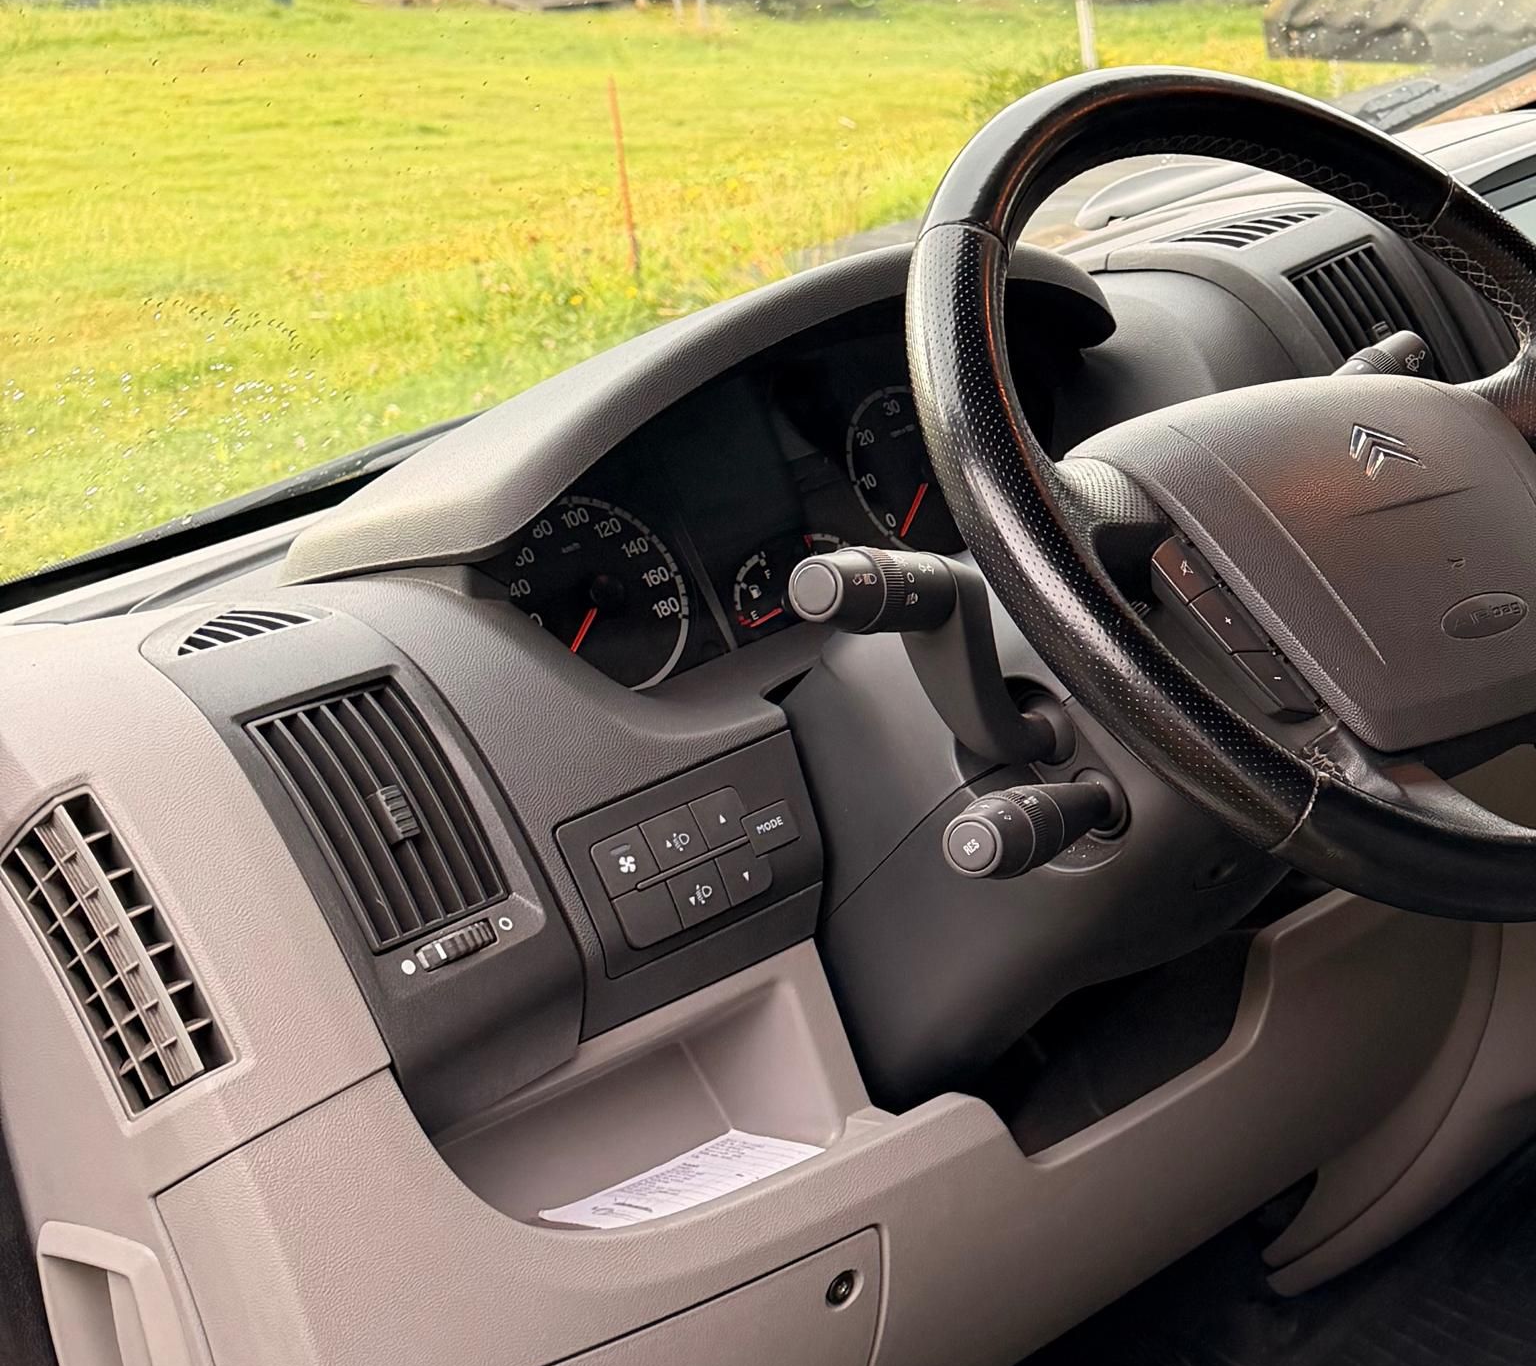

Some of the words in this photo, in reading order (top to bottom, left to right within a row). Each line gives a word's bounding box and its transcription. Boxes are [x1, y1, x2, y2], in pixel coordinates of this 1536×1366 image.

[882, 398, 901, 416] 30
[857, 428, 875, 447] 20
[860, 472, 878, 490] 10
[561, 507, 590, 528] 100
[593, 517, 622, 538] 120
[620, 536, 649, 559] 140
[641, 566, 670, 588] 160
[510, 578, 531, 598] 40
[652, 597, 679, 618] 180
[756, 815, 784, 835] MODE
[963, 839, 980, 855] RES
